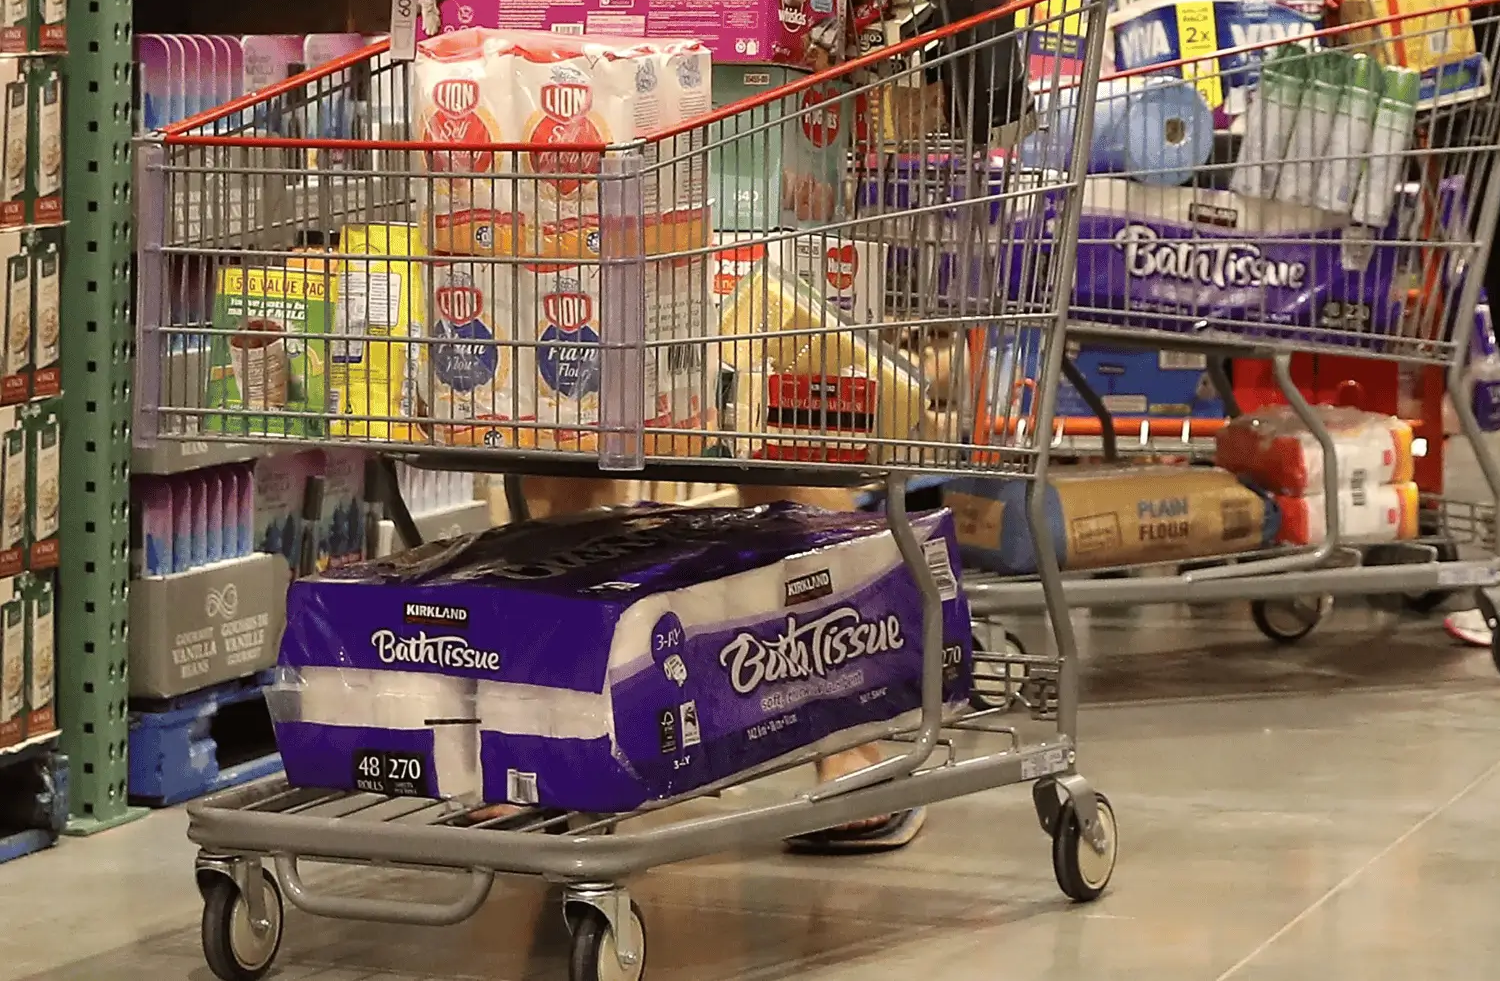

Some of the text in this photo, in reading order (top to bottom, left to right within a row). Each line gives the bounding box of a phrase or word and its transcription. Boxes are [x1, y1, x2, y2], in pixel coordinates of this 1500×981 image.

[437, 82, 475, 113] LION
[545, 86, 588, 118] LION
[440, 290, 478, 321] LON
[1138, 521, 1190, 541] FLOUR
[787, 571, 831, 597] KIRKLAND
[406, 603, 468, 621] KIRKLAND
[358, 755, 421, 780] 48 270
